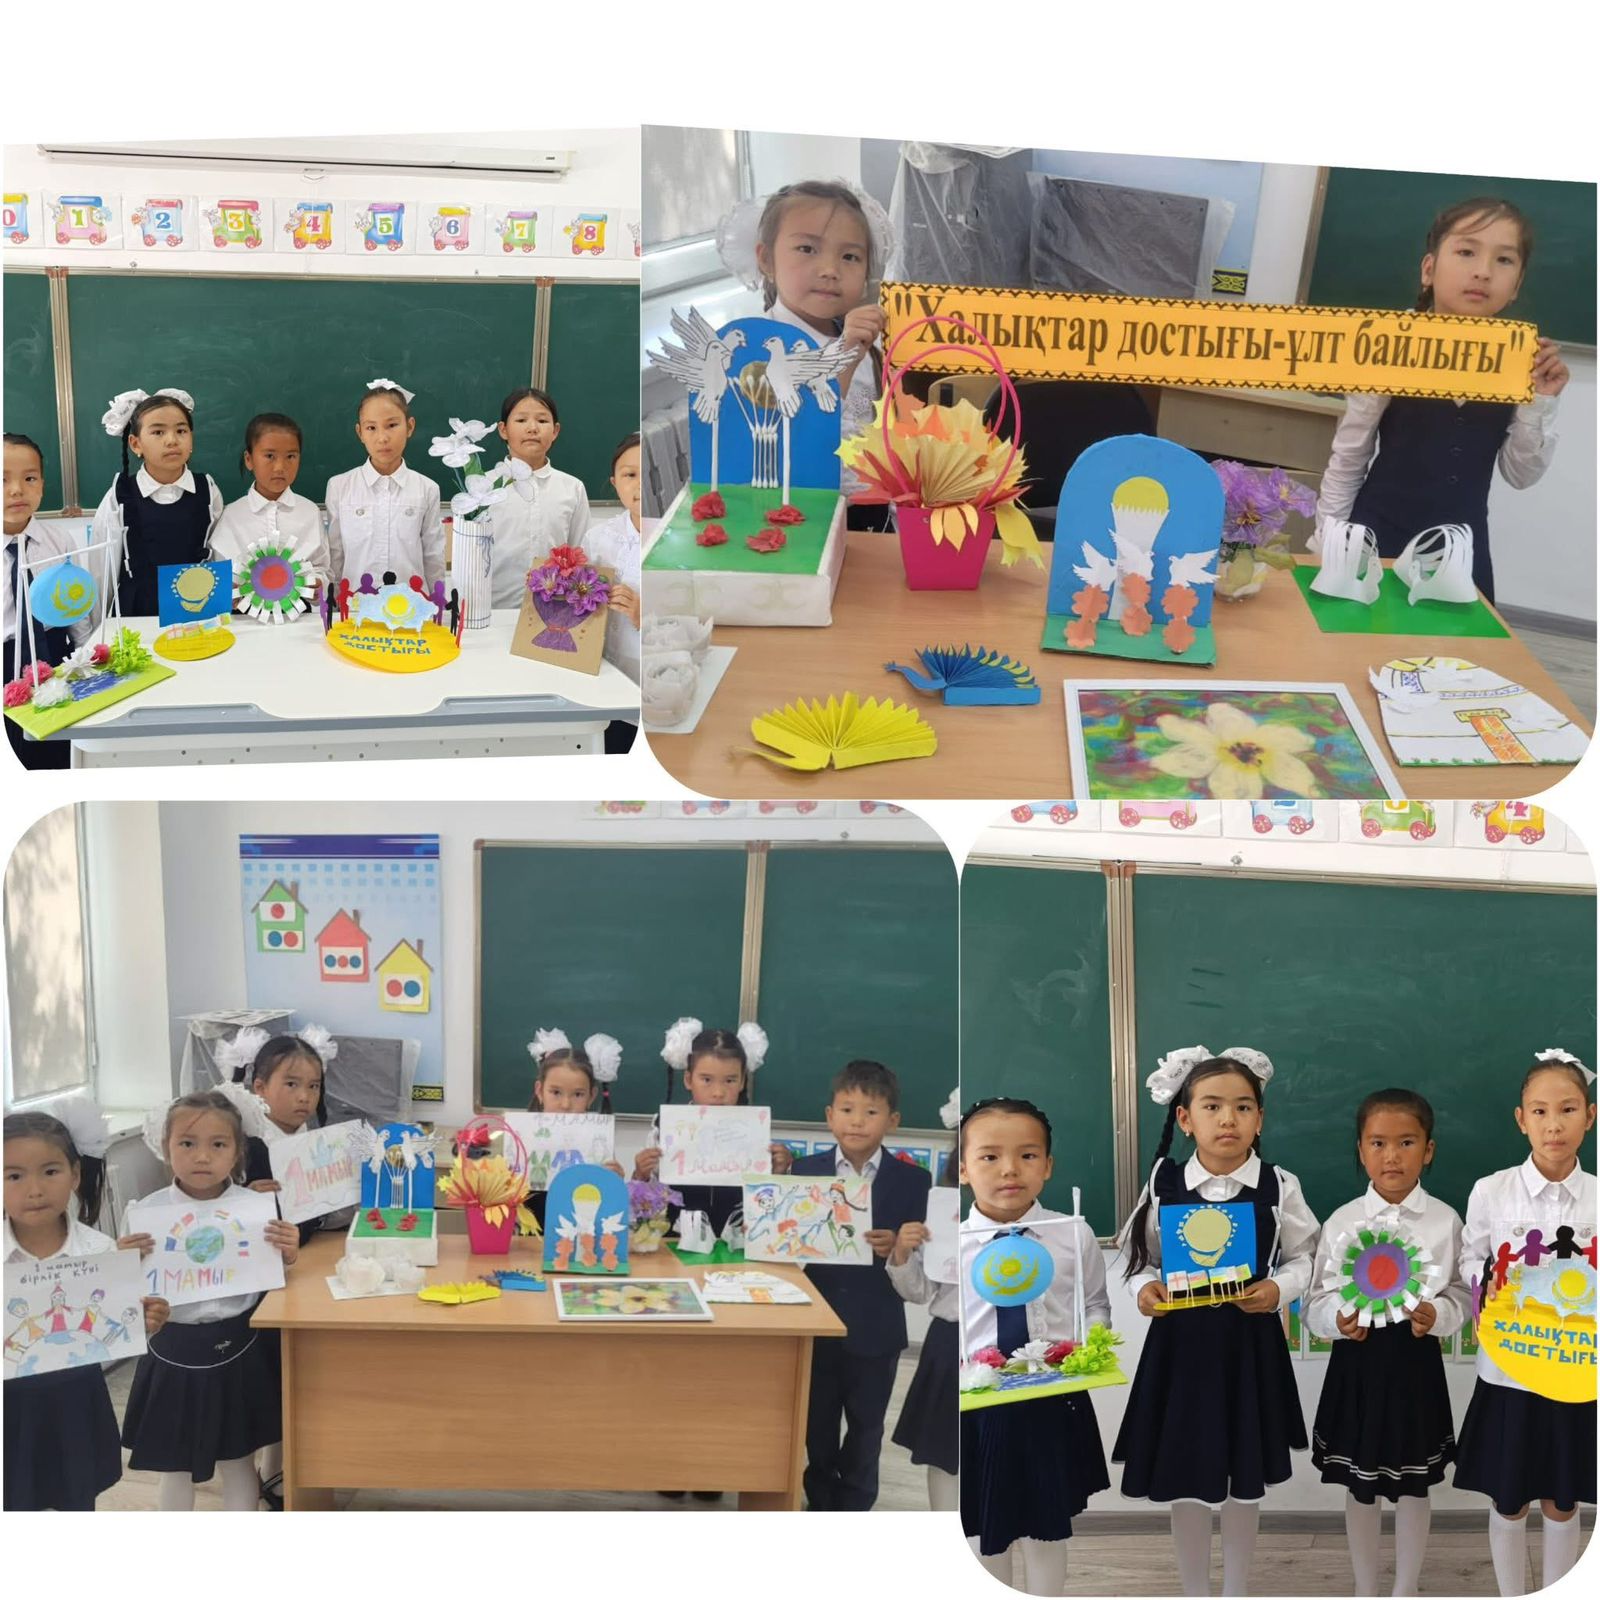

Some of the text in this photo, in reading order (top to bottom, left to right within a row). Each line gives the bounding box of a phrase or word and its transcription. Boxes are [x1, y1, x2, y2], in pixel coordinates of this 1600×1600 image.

[72, 209, 83, 226] 1
[155, 212, 171, 229] 2
[228, 213, 244, 229] 3
[306, 216, 320, 232] 4
[379, 217, 392, 233] 5
[446, 219, 459, 235] 6
[515, 223, 526, 238] 7
[584, 225, 596, 240] 8
[894, 292, 1525, 376] "Халықтар достығы-ұлт байлығы"
[1494, 1320, 1597, 1346] ХАЛЫҚТА
